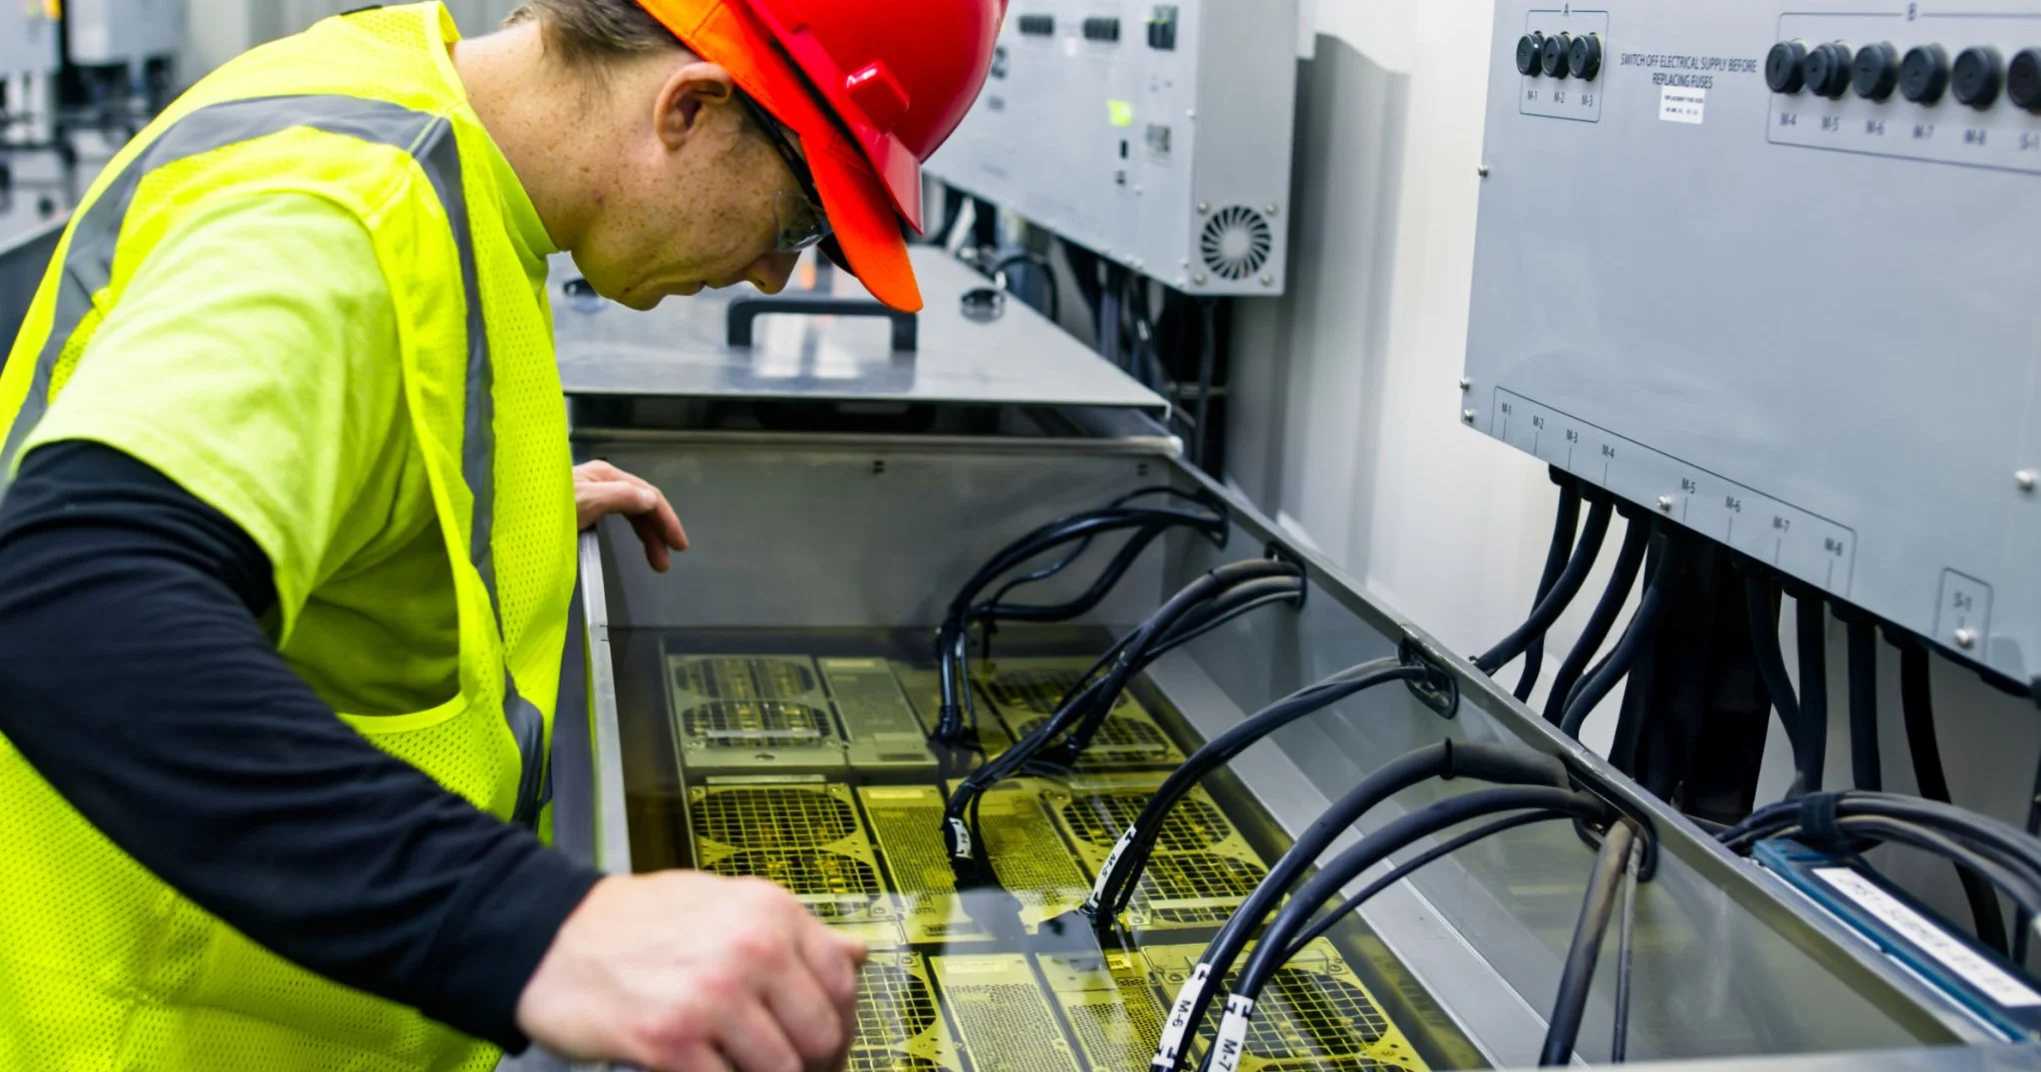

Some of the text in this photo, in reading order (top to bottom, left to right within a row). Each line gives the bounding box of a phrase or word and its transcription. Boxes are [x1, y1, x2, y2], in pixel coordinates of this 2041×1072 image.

[1563, 4, 1569, 17] A
[1620, 53, 1758, 73] SWITCH OFF ELECTRICAL SUPPLY BEFORE
[1652, 73, 1713, 89] REPLACING FUSES
[1780, 113, 1797, 127] M-4
[1822, 116, 1839, 131] M-5
[1866, 120, 1885, 136] M-6
[1501, 402, 1510, 415] M-1
[1533, 415, 1544, 430] M-2
[1567, 429, 1578, 444] M-3
[1602, 444, 1614, 459] M-4
[1682, 478, 1696, 495] M-5
[1726, 496, 1741, 514] M-6
[1773, 516, 1790, 534] M-7
[1102, 853, 1116, 879] M-5
[1172, 1000, 1192, 1027] M-6
[1219, 1039, 1238, 1071] M-7
